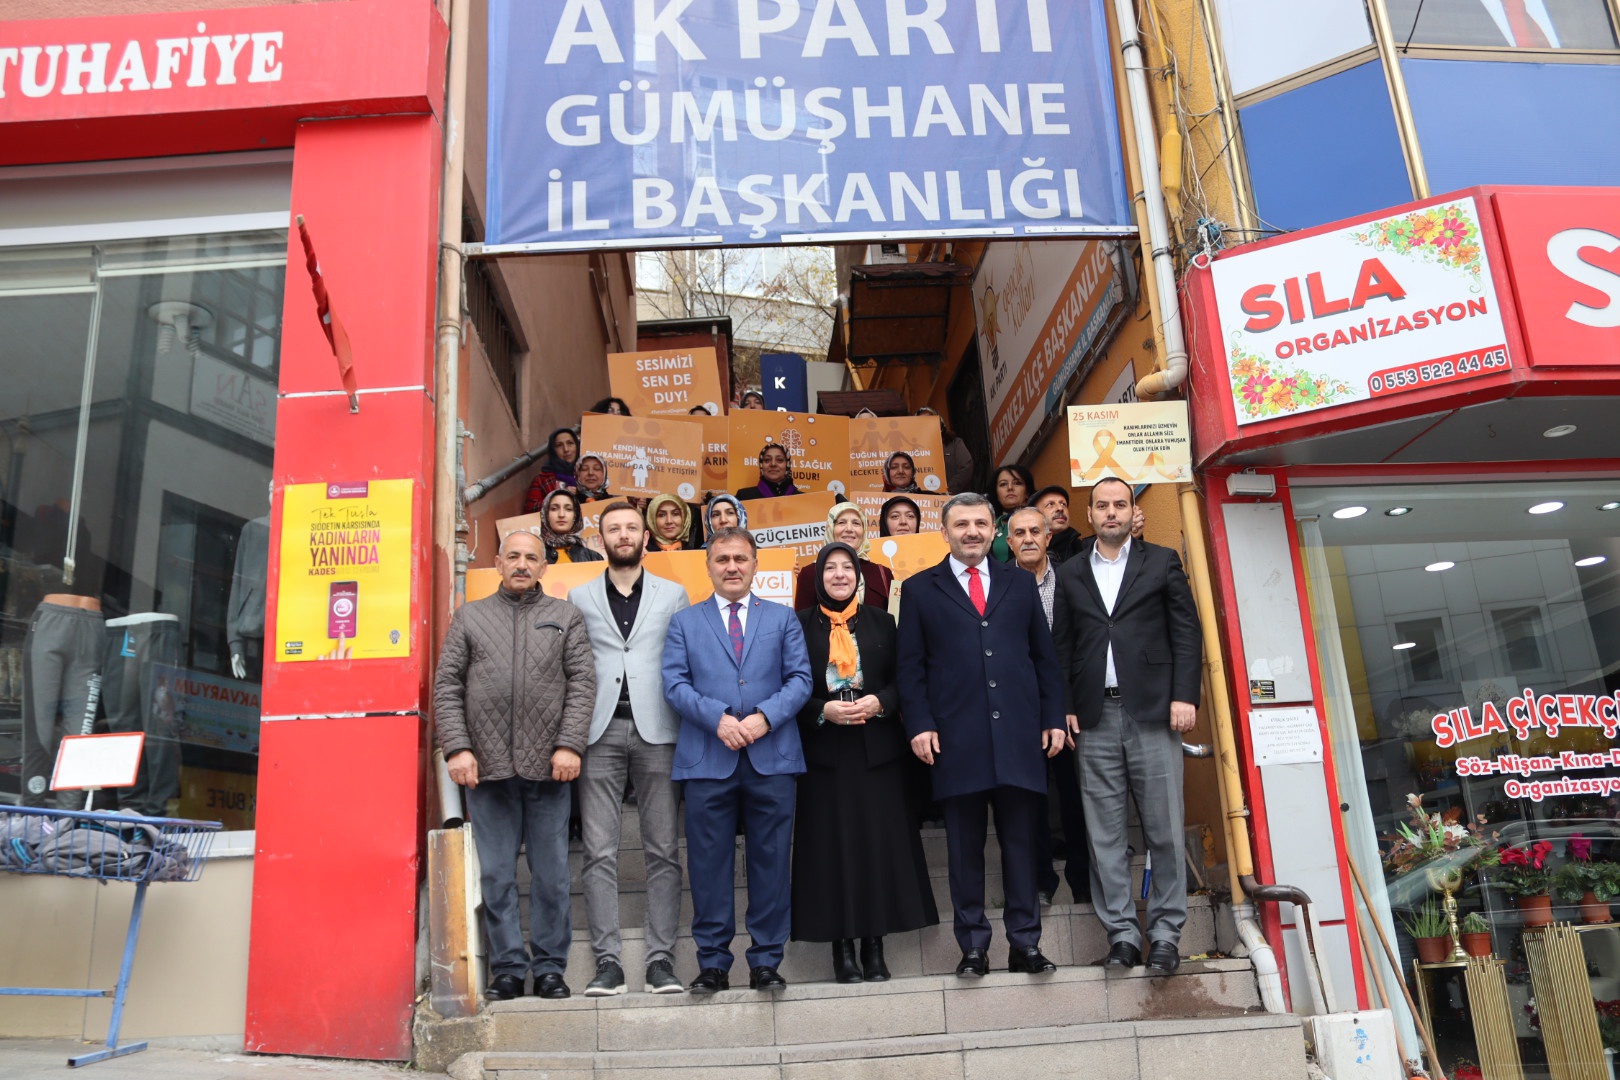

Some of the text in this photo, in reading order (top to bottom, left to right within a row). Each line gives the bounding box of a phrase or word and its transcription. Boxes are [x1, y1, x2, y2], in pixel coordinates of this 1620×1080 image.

[544, 0, 707, 64] AK
[546, 77, 1071, 154] GÜMÜŞHANE
[548, 157, 1084, 239] İL BAŞKANLIĞI
[1240, 258, 1407, 333] SILA
[1275, 297, 1488, 359] ORGANİZASYON
[636, 354, 693, 371] SESİMİZİ
[1371, 349, 1506, 392] 0 553 522 44 45
[642, 373, 692, 388] SEN DE
[654, 390, 688, 404] DUY!
[993, 385, 1024, 458] MERKEZ
[1023, 351, 1045, 403] İLÇE
[1073, 410, 1119, 421] 25 KASIM
[648, 446, 668, 455] NASIL
[744, 456, 759, 467] BİR
[800, 459, 833, 470] SAĞLIK
[310, 529, 380, 546] KADINLARIN
[310, 545, 379, 567] YANINDA
[309, 568, 336, 576] KADES
[1432, 701, 1508, 748] SILA
